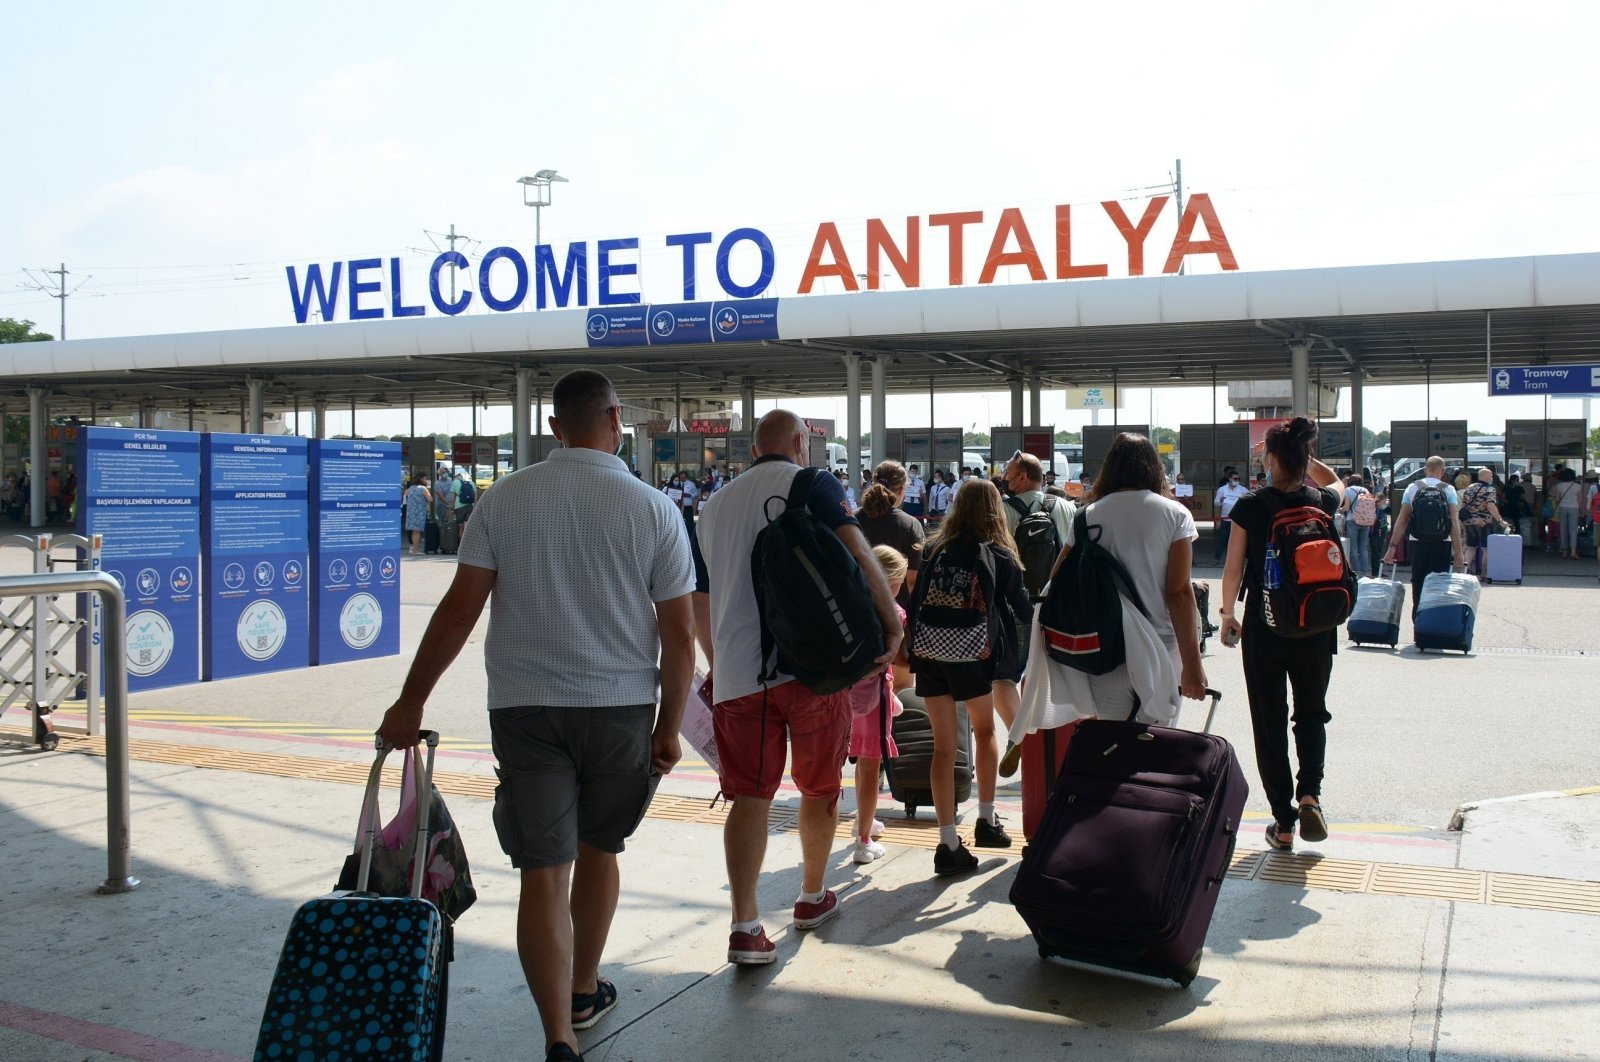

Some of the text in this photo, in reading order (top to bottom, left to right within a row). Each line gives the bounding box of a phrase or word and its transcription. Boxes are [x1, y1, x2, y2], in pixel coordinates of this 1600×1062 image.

[286, 193, 1240, 324] WELCOME TO ANTALYA
[1522, 368, 1569, 379] Tramvay
[1522, 380, 1548, 389] Tram
[124, 442, 167, 451] GENEL BİLGİLER
[96, 498, 123, 506] BAŞVURU
[124, 497, 153, 506] İŞLEMİNDE
[92, 558, 100, 646] PLİS
[354, 613, 369, 621] SAFE
[254, 621, 271, 630] SAFE
[349, 618, 374, 627] TOURISM
[248, 627, 276, 637] TOURISM
[136, 633, 155, 642] SAFE
[129, 640, 162, 650] TOURISM
